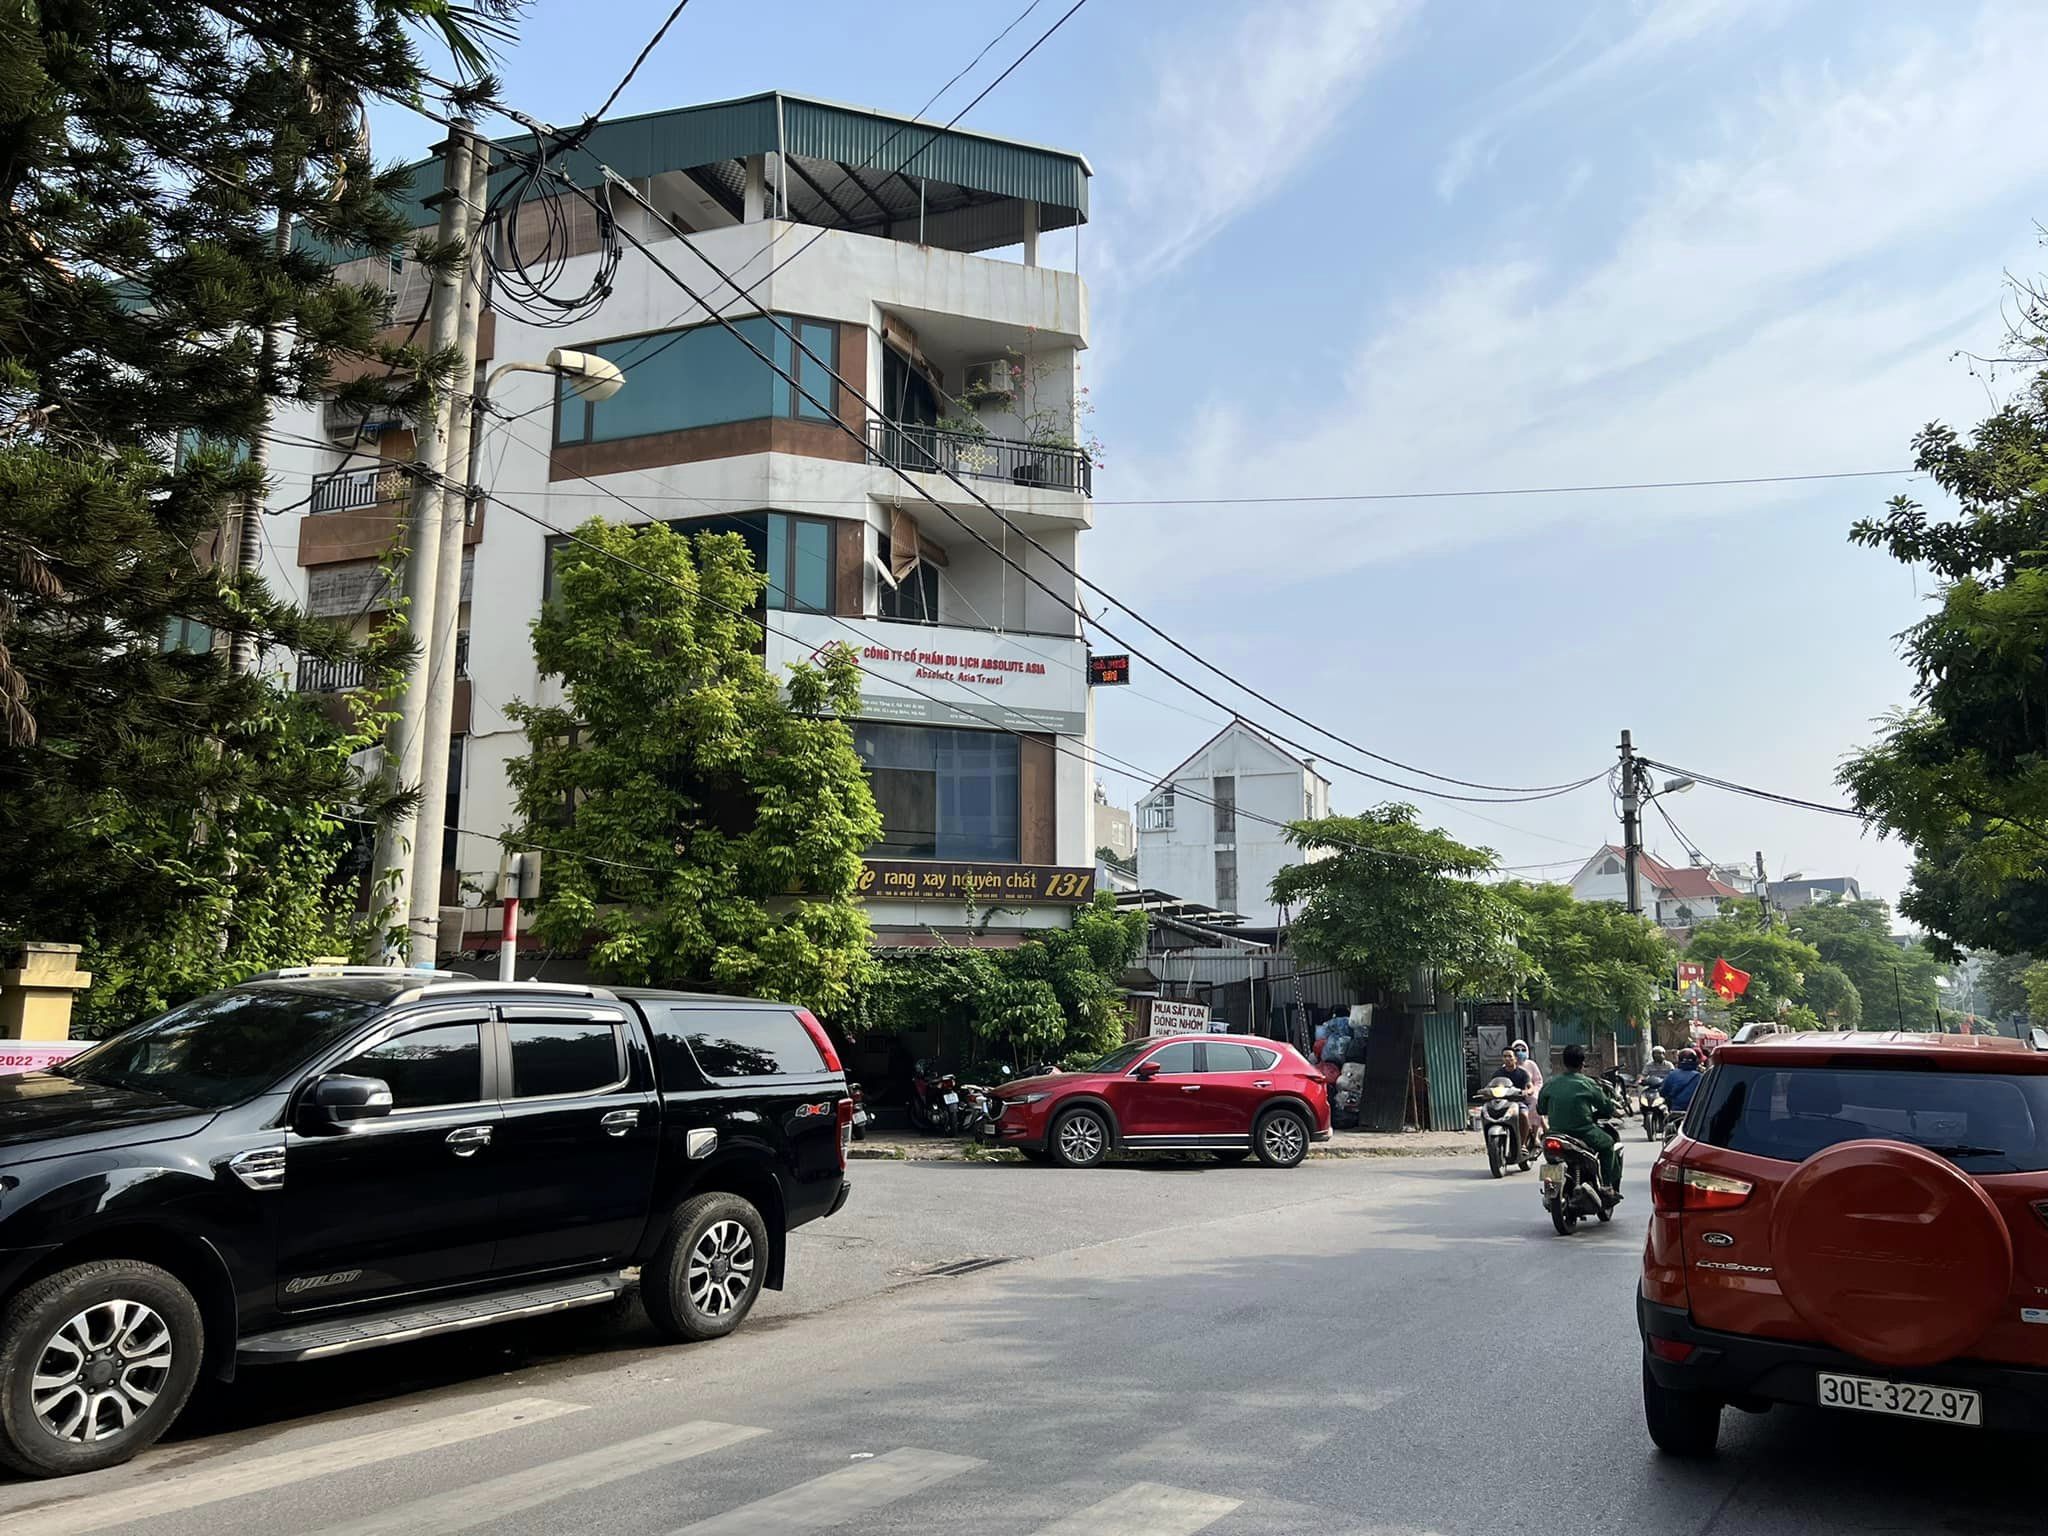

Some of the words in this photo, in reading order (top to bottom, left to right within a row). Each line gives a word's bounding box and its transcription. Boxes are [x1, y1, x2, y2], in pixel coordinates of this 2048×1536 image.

[864, 645, 890, 660] CÔNG
[945, 655, 958, 666] DU
[959, 656, 980, 669] LỊCH
[981, 658, 1024, 672] ABSOLUTE
[1025, 662, 1046, 675] ASIA
[915, 667, 955, 683] Absolute
[958, 672, 975, 683] Asia
[976, 673, 1003, 685] Travel
[884, 872, 916, 889] rang
[922, 873, 946, 890] xay
[952, 871, 1002, 891] nguyên
[1006, 869, 1037, 889] chất
[1044, 874, 1091, 897] 131
[1154, 1002, 1171, 1014] MUA
[0, 1056, 33, 1066] 2022
[1822, 1377, 1976, 1423] 30E-322.97
